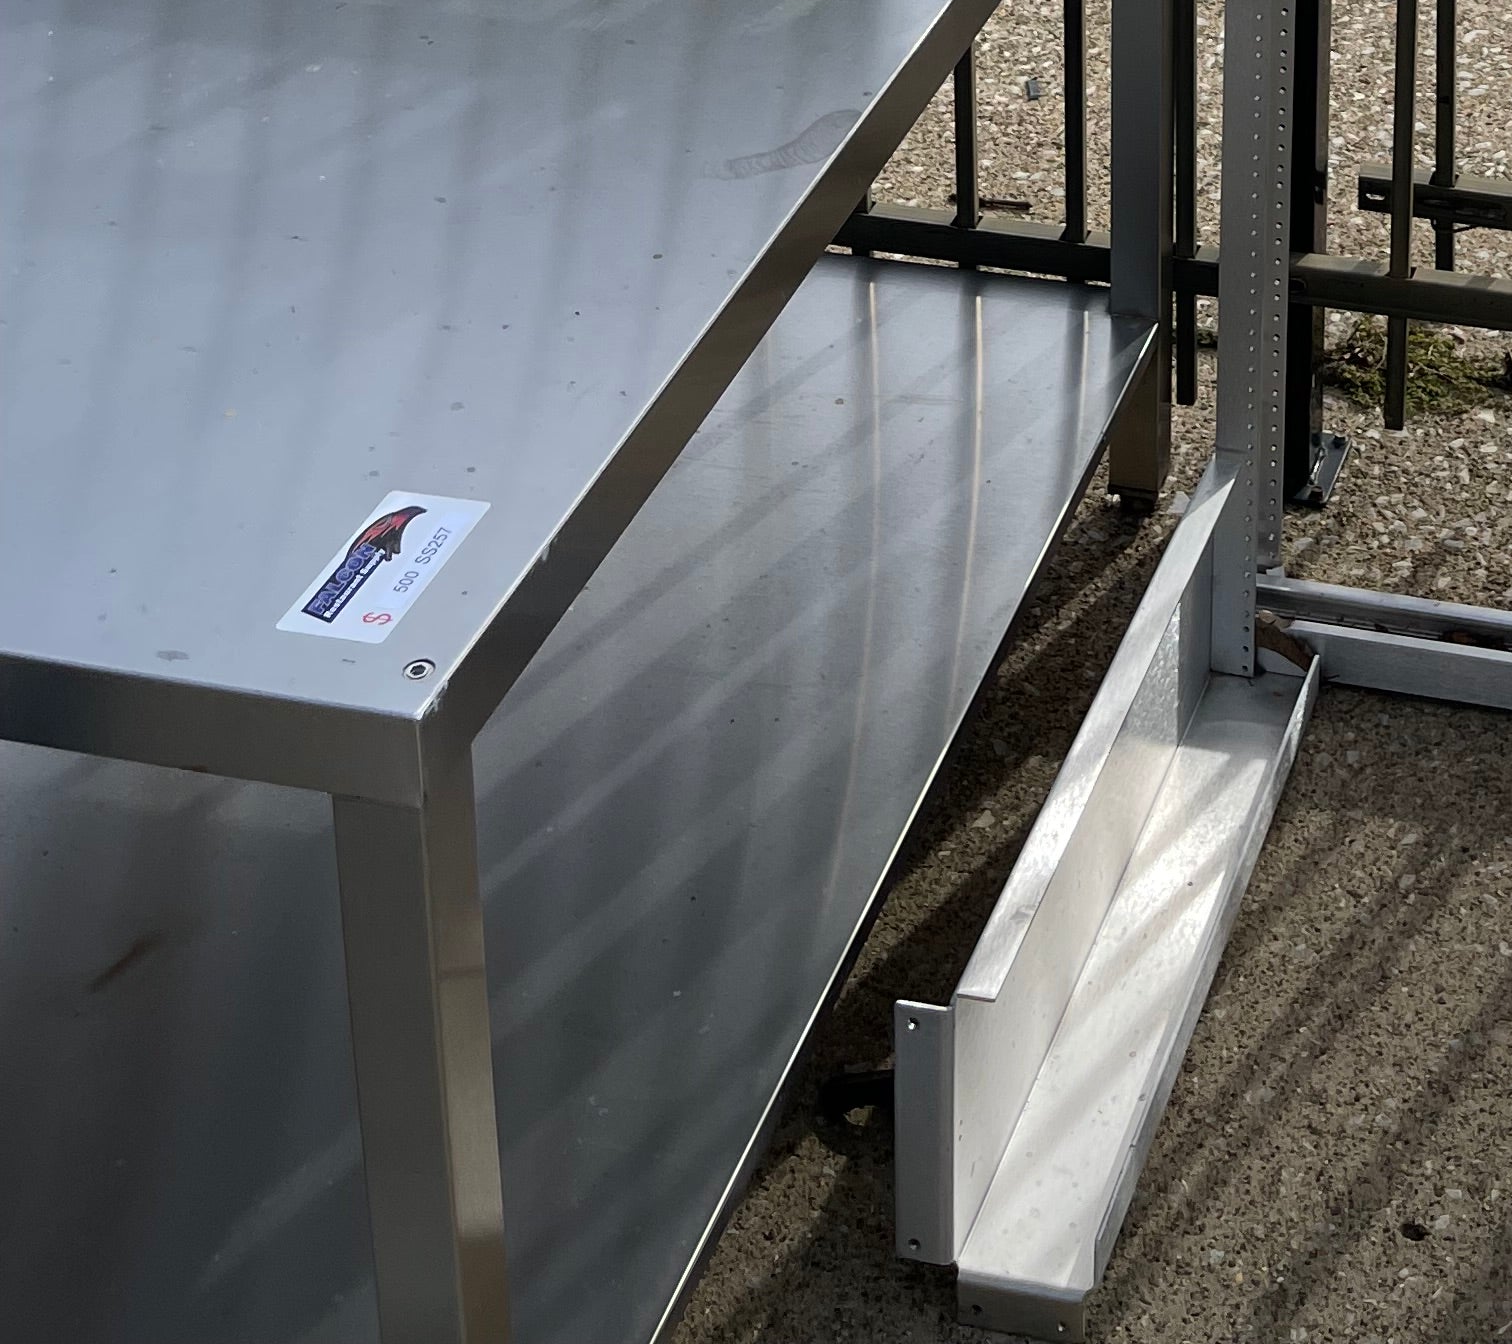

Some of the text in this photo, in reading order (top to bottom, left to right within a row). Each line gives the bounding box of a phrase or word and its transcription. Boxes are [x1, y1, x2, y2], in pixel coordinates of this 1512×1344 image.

[308, 543, 376, 614] FALCON
[393, 570, 420, 593] 500
[415, 527, 452, 565] SS257
